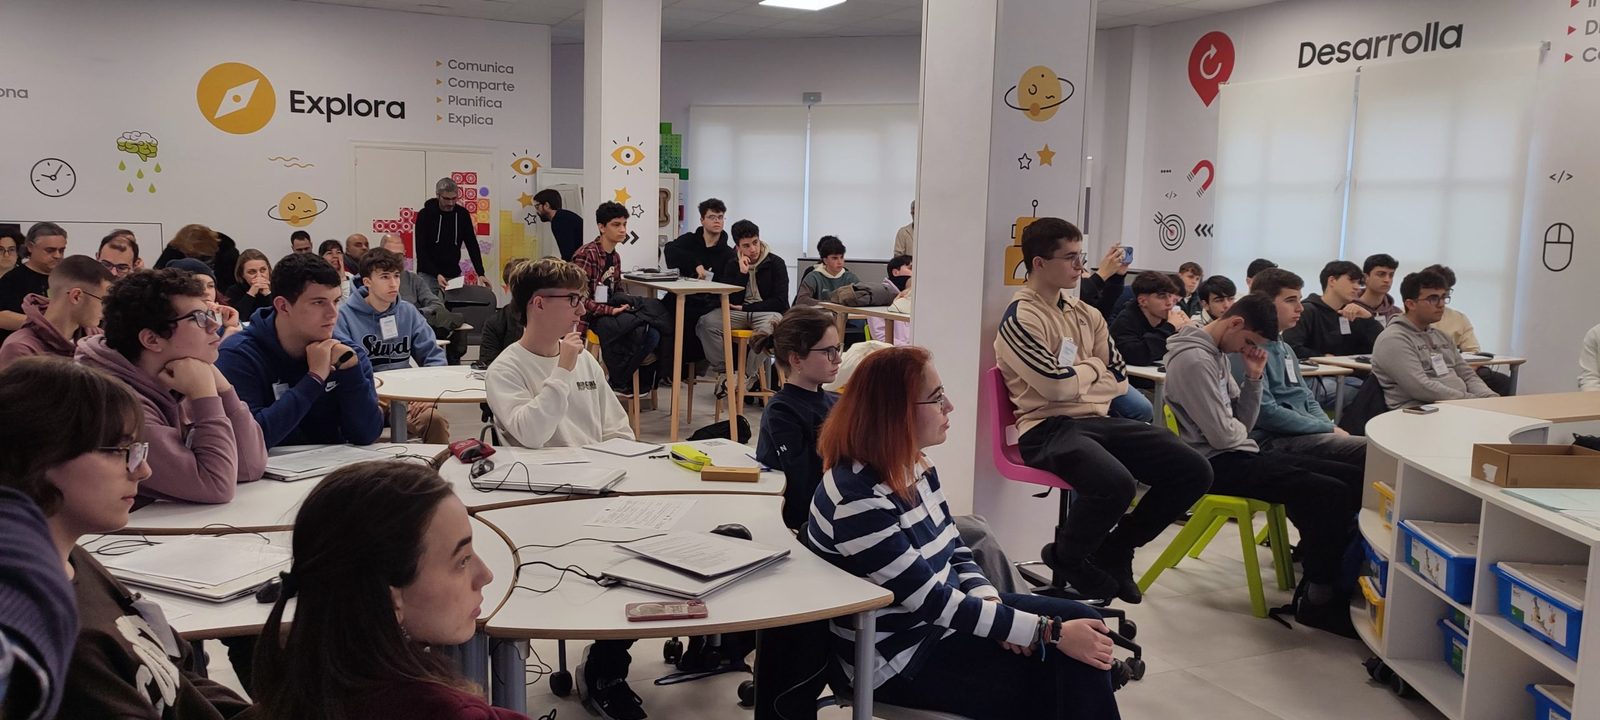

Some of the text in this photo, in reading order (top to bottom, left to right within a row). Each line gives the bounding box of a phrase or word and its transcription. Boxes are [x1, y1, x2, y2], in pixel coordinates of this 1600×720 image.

[1298, 21, 1464, 68] Desarrolla
[447, 59, 514, 74] Comunica
[447, 77, 515, 93] Comparte
[289, 90, 406, 123] Explora
[447, 95, 503, 108] Planifica
[448, 112, 494, 127] Explica
